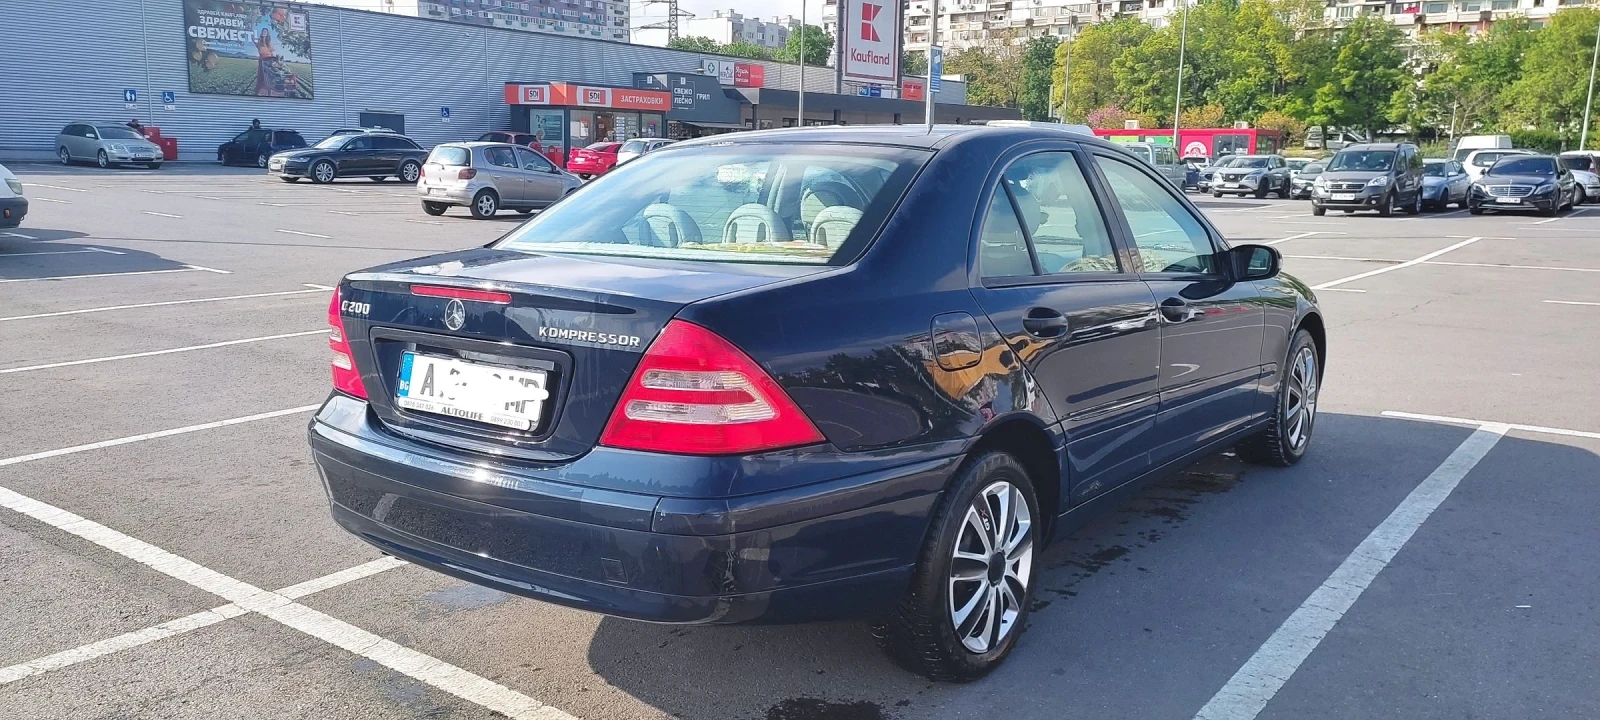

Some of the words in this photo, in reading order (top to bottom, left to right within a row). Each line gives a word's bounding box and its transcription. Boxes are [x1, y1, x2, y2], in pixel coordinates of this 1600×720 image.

[188, 25, 259, 43] СВЕЖЕСТ!
[850, 48, 890, 66] Kaufland
[589, 92, 600, 100] SDI
[673, 87, 693, 95] СВЕЖО
[620, 94, 664, 105] ЗАСТРАХОВКИ
[673, 97, 693, 105] ЛЕСНО
[696, 93, 711, 101] ГРИЛ
[539, 326, 641, 347] KOMPRESSOR
[399, 379, 410, 391] BG
[440, 406, 484, 421] AUTOLIFE
